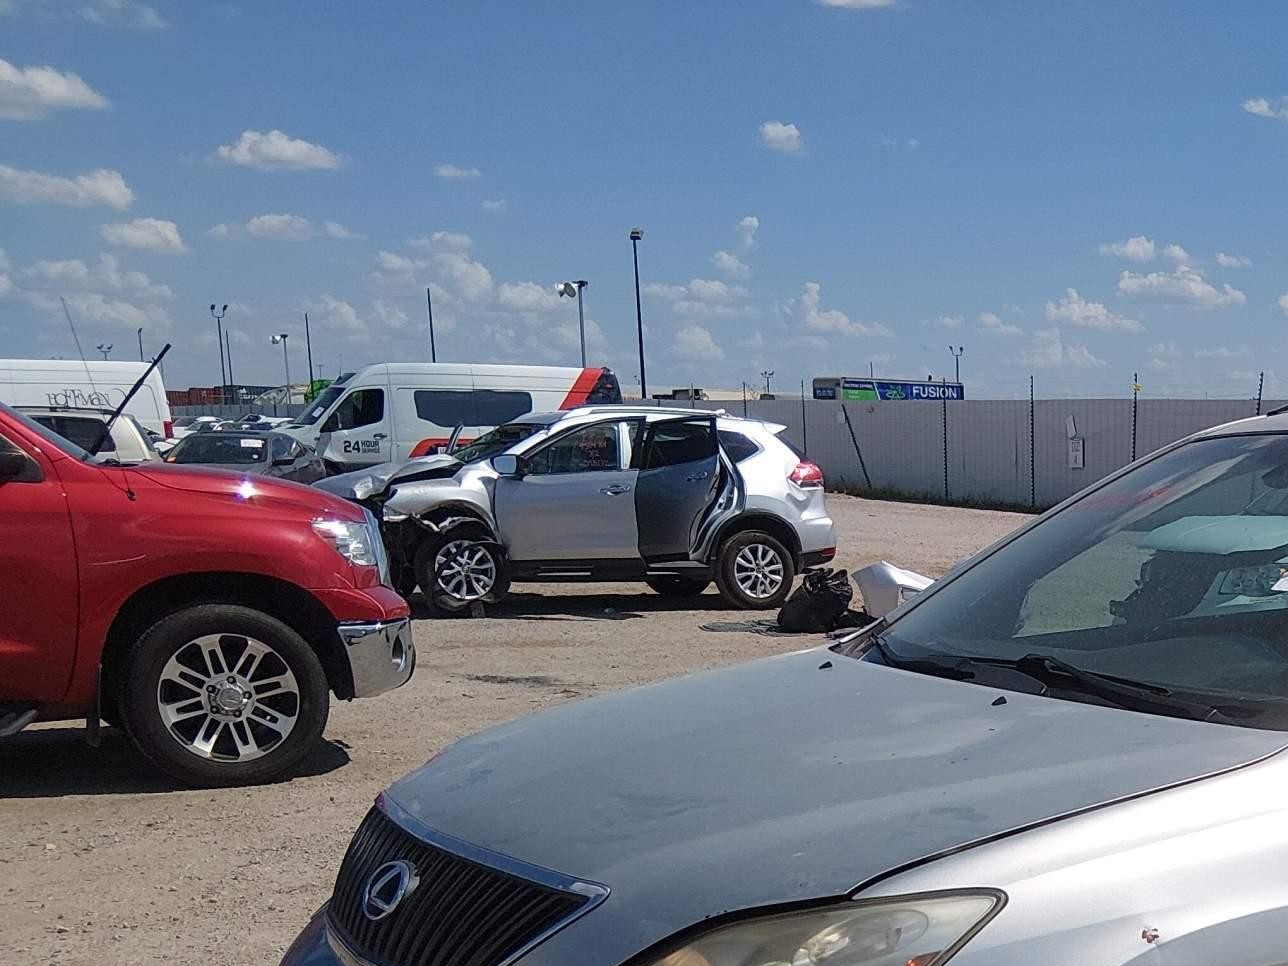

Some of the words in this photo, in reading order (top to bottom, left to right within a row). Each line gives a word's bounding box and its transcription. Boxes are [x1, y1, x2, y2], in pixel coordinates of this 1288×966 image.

[913, 385, 957, 399] FUSION
[343, 440, 360, 453] 24
[361, 440, 380, 448] HOUR
